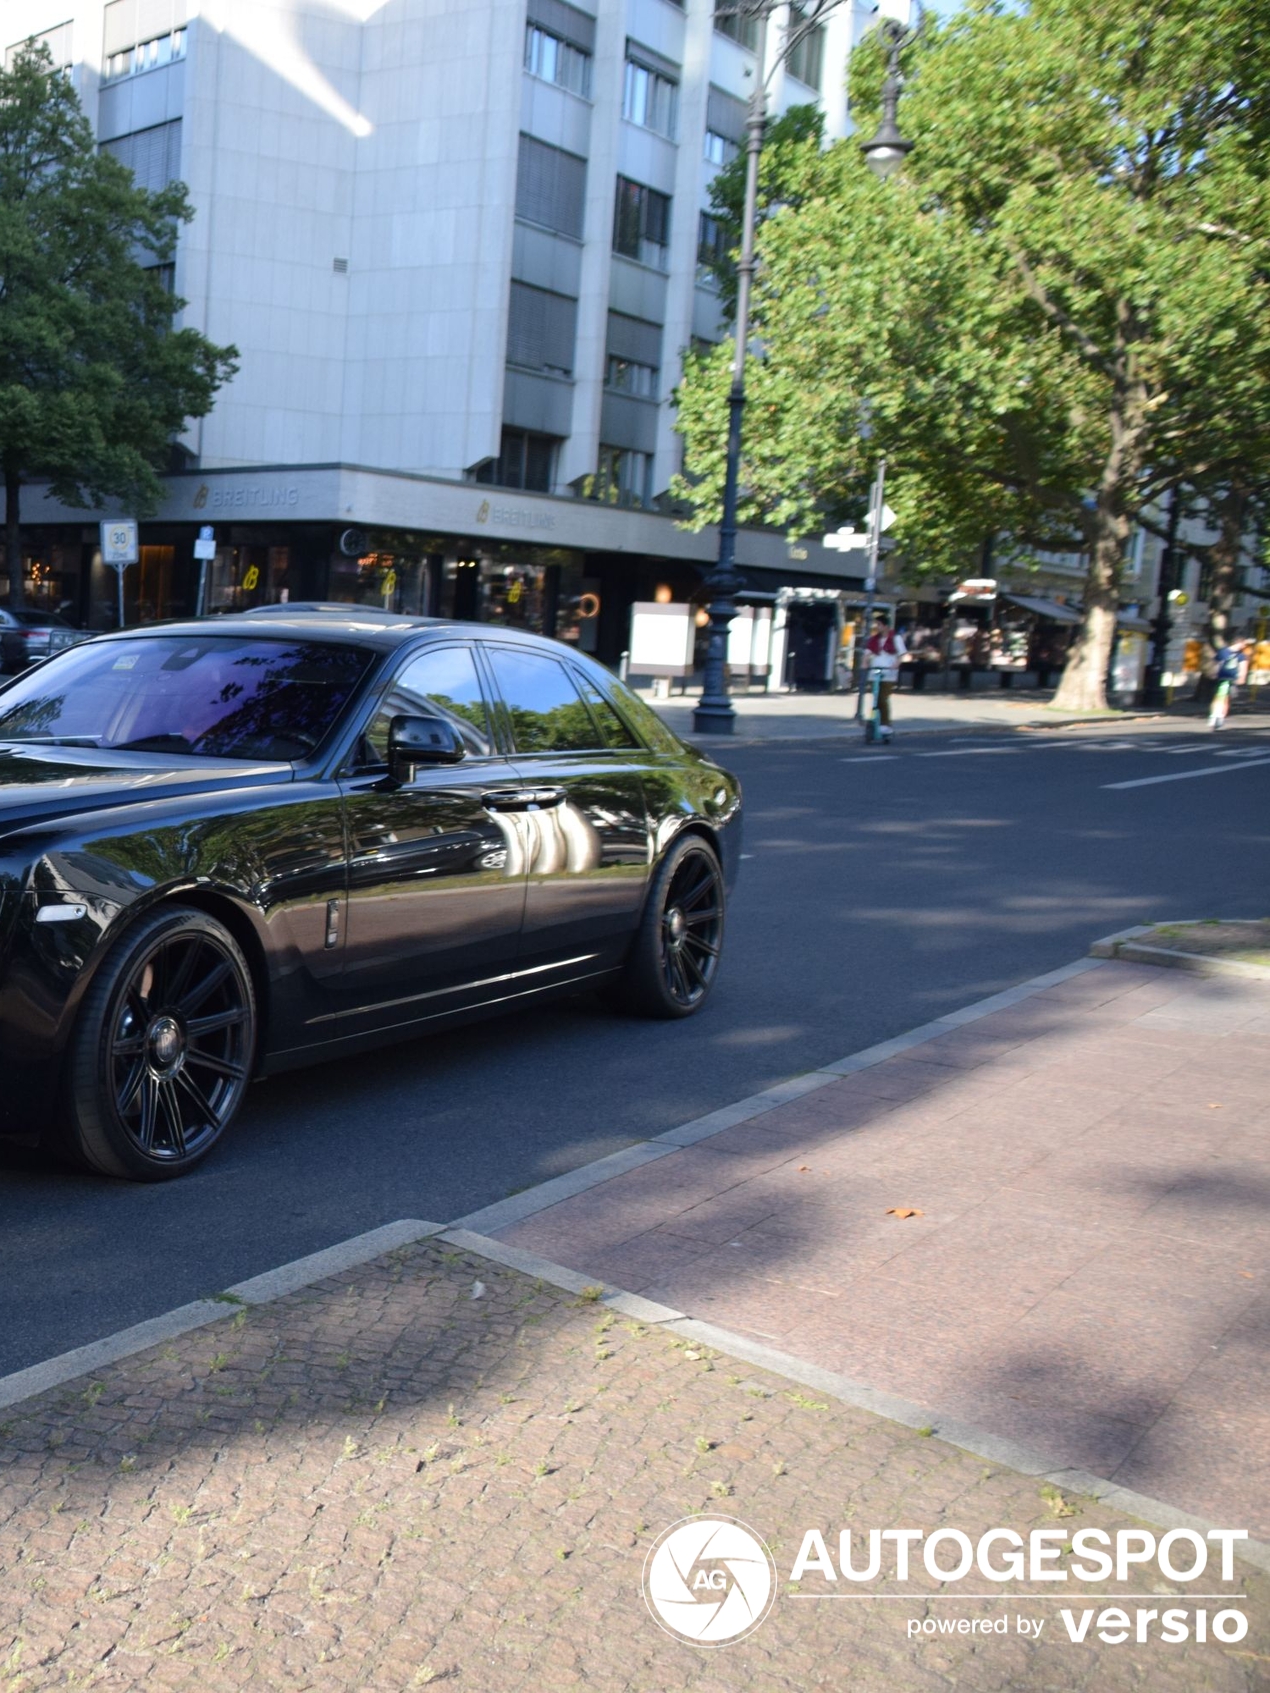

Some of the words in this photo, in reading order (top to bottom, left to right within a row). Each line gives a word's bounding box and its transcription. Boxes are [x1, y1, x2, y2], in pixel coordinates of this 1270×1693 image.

[212, 487, 299, 508] BREITLING
[493, 507, 557, 530] BREITLING
[113, 532, 126, 544] 30
